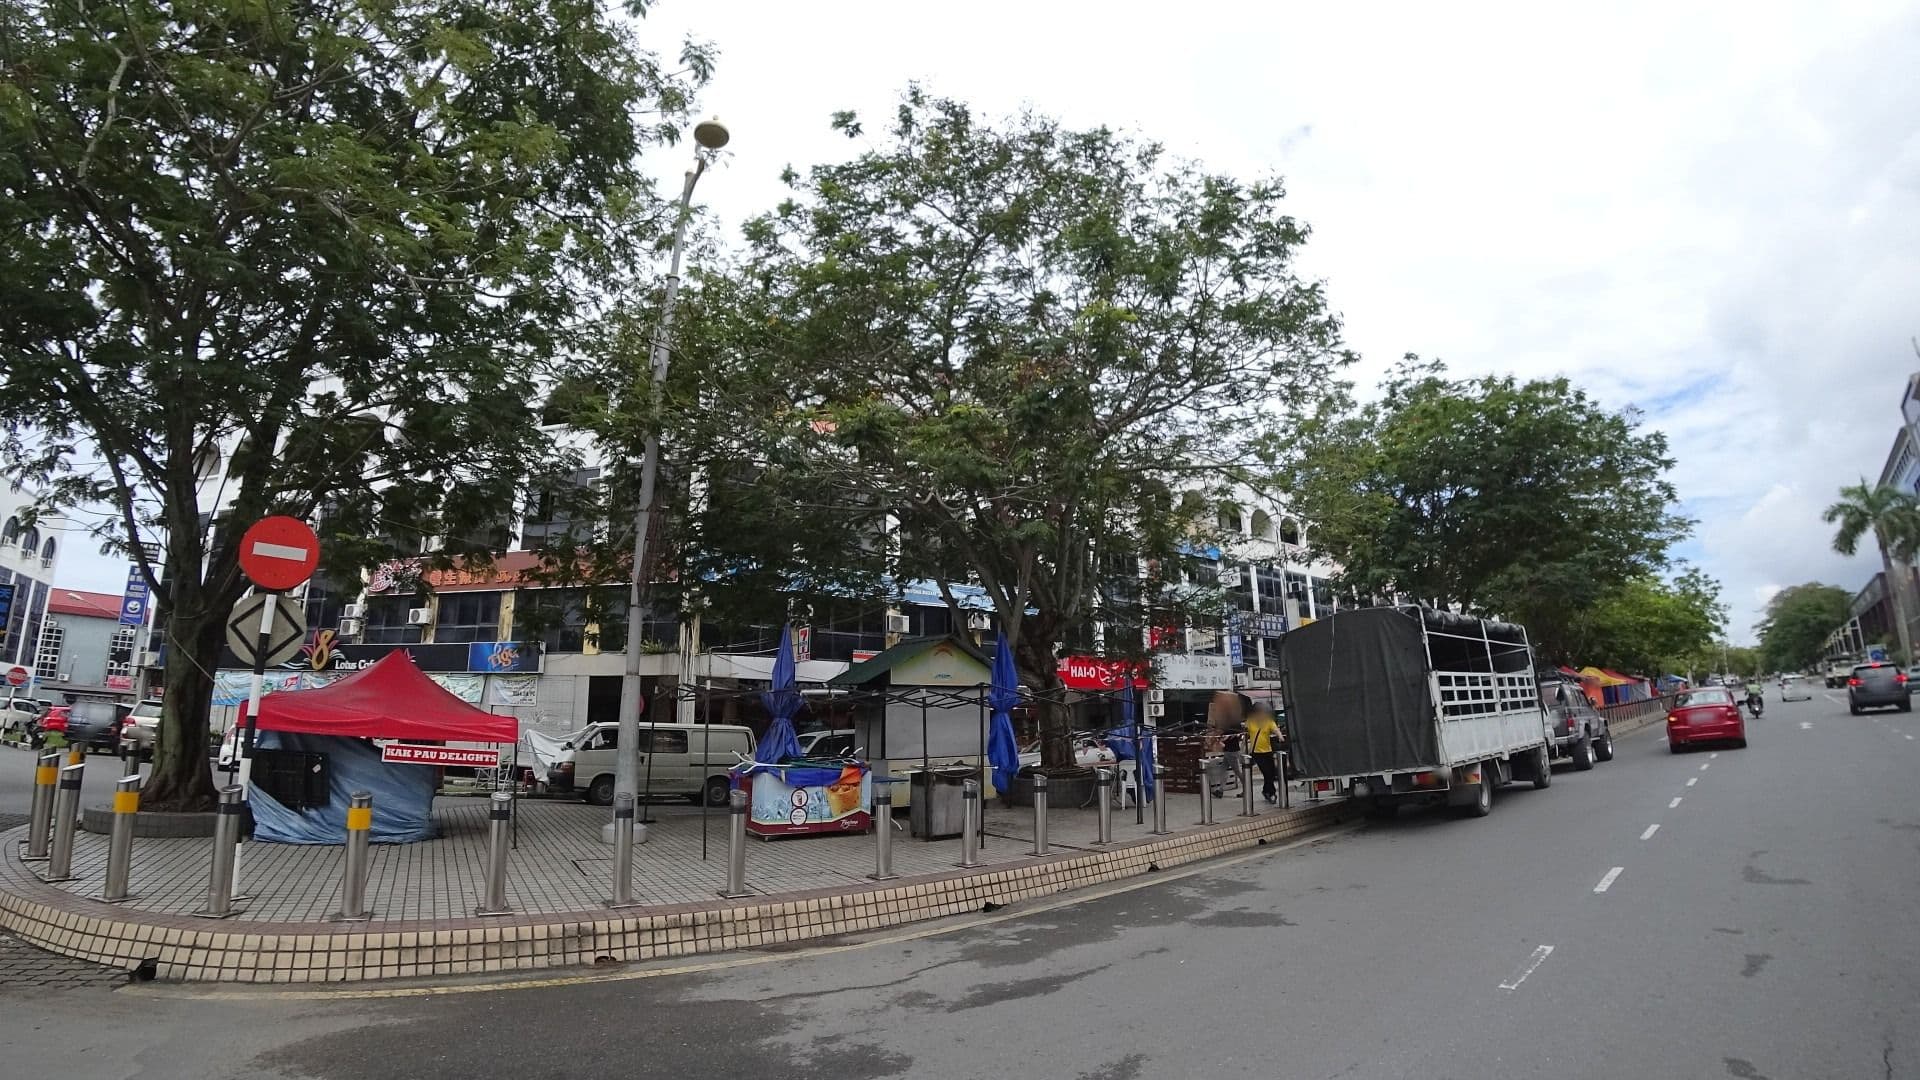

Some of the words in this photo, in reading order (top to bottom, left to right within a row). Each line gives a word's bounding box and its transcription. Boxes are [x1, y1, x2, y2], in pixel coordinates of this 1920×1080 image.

[335, 659, 357, 670] Lotus
[1070, 665, 1096, 678] HAI-O
[385, 747, 412, 758] KAK
[413, 750, 437, 759] PAU
[438, 751, 497, 763] DELIGHTS
